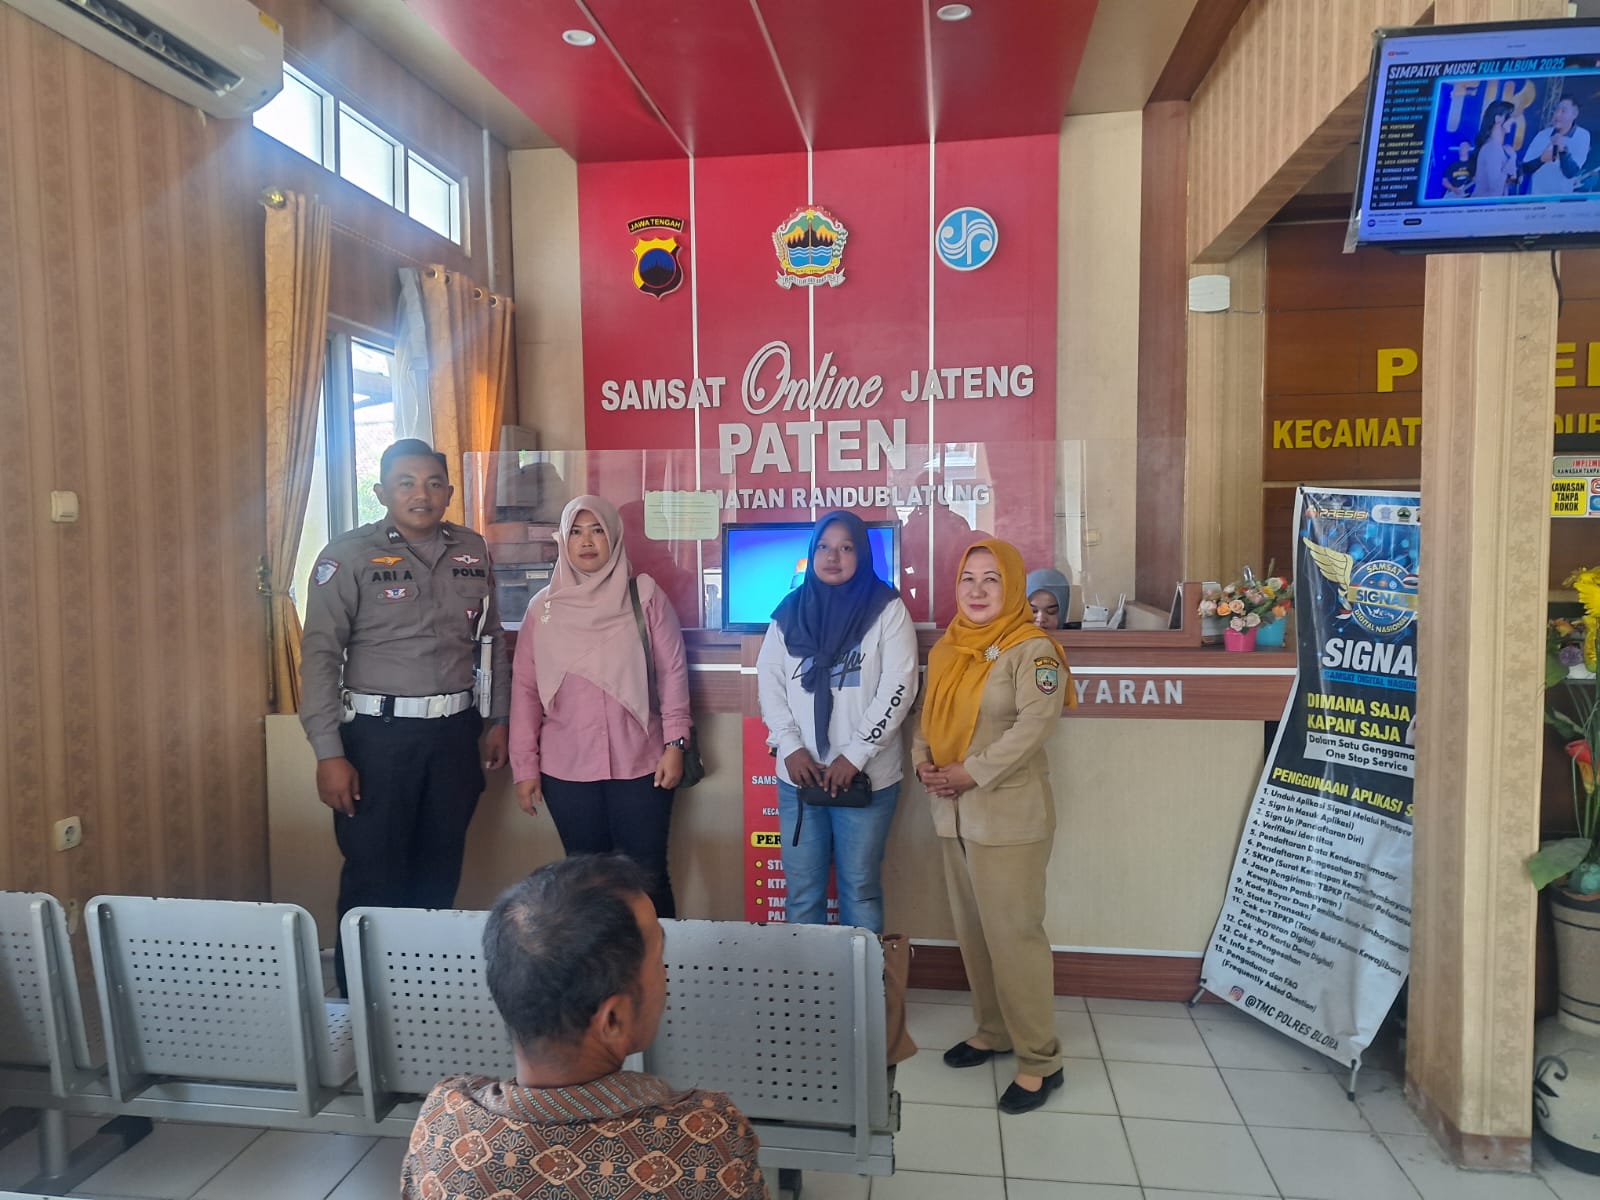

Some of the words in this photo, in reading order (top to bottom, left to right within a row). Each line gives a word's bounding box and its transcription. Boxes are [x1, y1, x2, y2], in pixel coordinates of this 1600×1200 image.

[1389, 65, 1441, 80] SIMPATIK
[1443, 62, 1476, 74] MUSIC
[1478, 61, 1500, 74] FULL
[1502, 59, 1537, 72] ALBUM
[1538, 58, 1565, 70] 2025
[630, 220, 650, 230] JAWA
[650, 218, 680, 229] TENGAH
[601, 376, 726, 412] SAMSAT
[741, 340, 884, 415] Online
[900, 364, 1034, 402] JATENG
[718, 418, 906, 474] PATEN
[792, 485, 990, 508] RANDUBLATUNG
[1552, 482, 1585, 492] KAWASAN
[1557, 492, 1578, 502] TANPA
[1319, 508, 1369, 520] PRESISI
[1554, 502, 1578, 512] ROKOK
[372, 571, 396, 582] ARI
[1366, 563, 1402, 576] SAMSAT
[1354, 609, 1374, 631] DIGITAL
[1322, 638, 1417, 677] SIGNA
[1308, 692, 1366, 715] DIMANA
[1370, 701, 1410, 722] SAJA
[1308, 714, 1356, 734] KAPAN
[1360, 722, 1400, 742] SAJA
[1308, 734, 1336, 746] Dalam
[1338, 739, 1360, 750] Satu
[1326, 748, 1346, 760] One
[1348, 752, 1370, 766] Stop
[1372, 757, 1408, 772] Service
[1271, 790, 1296, 802] Unduh
[1272, 767, 1350, 798] PENGGUNAAN
[1351, 787, 1404, 814] APLIKASI
[1259, 798, 1266, 806] 2.
[1268, 800, 1286, 812] Sign
[1320, 814, 1355, 831] Aplikasi)
[1262, 821, 1298, 836] Verifikasi
[1264, 810, 1283, 822] Sign
[1284, 816, 1294, 826] Up
[1347, 832, 1364, 846] Diri)
[1247, 838, 1254, 846] 6.
[1256, 842, 1304, 862] Pendaftaran
[1250, 828, 1256, 836] 5.
[1258, 831, 1306, 850] Pendaftaran
[1244, 848, 1251, 856] 7.
[1252, 851, 1274, 864] SKKP
[1275, 858, 1300, 872] (Surat
[1242, 858, 1248, 866] 8.
[1250, 862, 1268, 874] Jasa
[1318, 882, 1342, 896] TBPKP
[1246, 870, 1288, 892] Kewajiban
[1234, 886, 1245, 896] 10.
[1246, 892, 1272, 906] Status
[1274, 901, 1312, 921] Transaksi
[1236, 877, 1244, 885] 9.
[1245, 880, 1266, 893] Kode
[1267, 888, 1292, 902] Bayar
[1292, 898, 1310, 910] Dan
[1232, 896, 1241, 904] 11.
[1243, 900, 1258, 912] Cek
[1260, 908, 1294, 928] e-TBPKP
[1294, 920, 1319, 937] (Tanda
[1359, 949, 1401, 977] Kewajiban
[1238, 919, 1252, 930] Cek
[1270, 934, 1291, 948] Kartu
[1240, 908, 1289, 935] Pembayaran
[1290, 930, 1316, 948] Digital)
[1218, 934, 1228, 944] 14.
[1230, 938, 1245, 951] Info
[1246, 946, 1275, 966] Samsat
[1233, 928, 1248, 940] Cek
[1249, 938, 1302, 966] e-Pengesahan
[1215, 944, 1224, 954] 15.
[1226, 949, 1268, 975] Pengaduan
[1268, 970, 1284, 982] dan
[1284, 978, 1298, 990] FAQ
[1222, 959, 1264, 986] (Frequently
[1264, 981, 1286, 998] Asked
[1244, 995, 1276, 1017] @TMC
[1275, 1010, 1312, 1036] POLRES
[1310, 1029, 1338, 1050] BLORA
